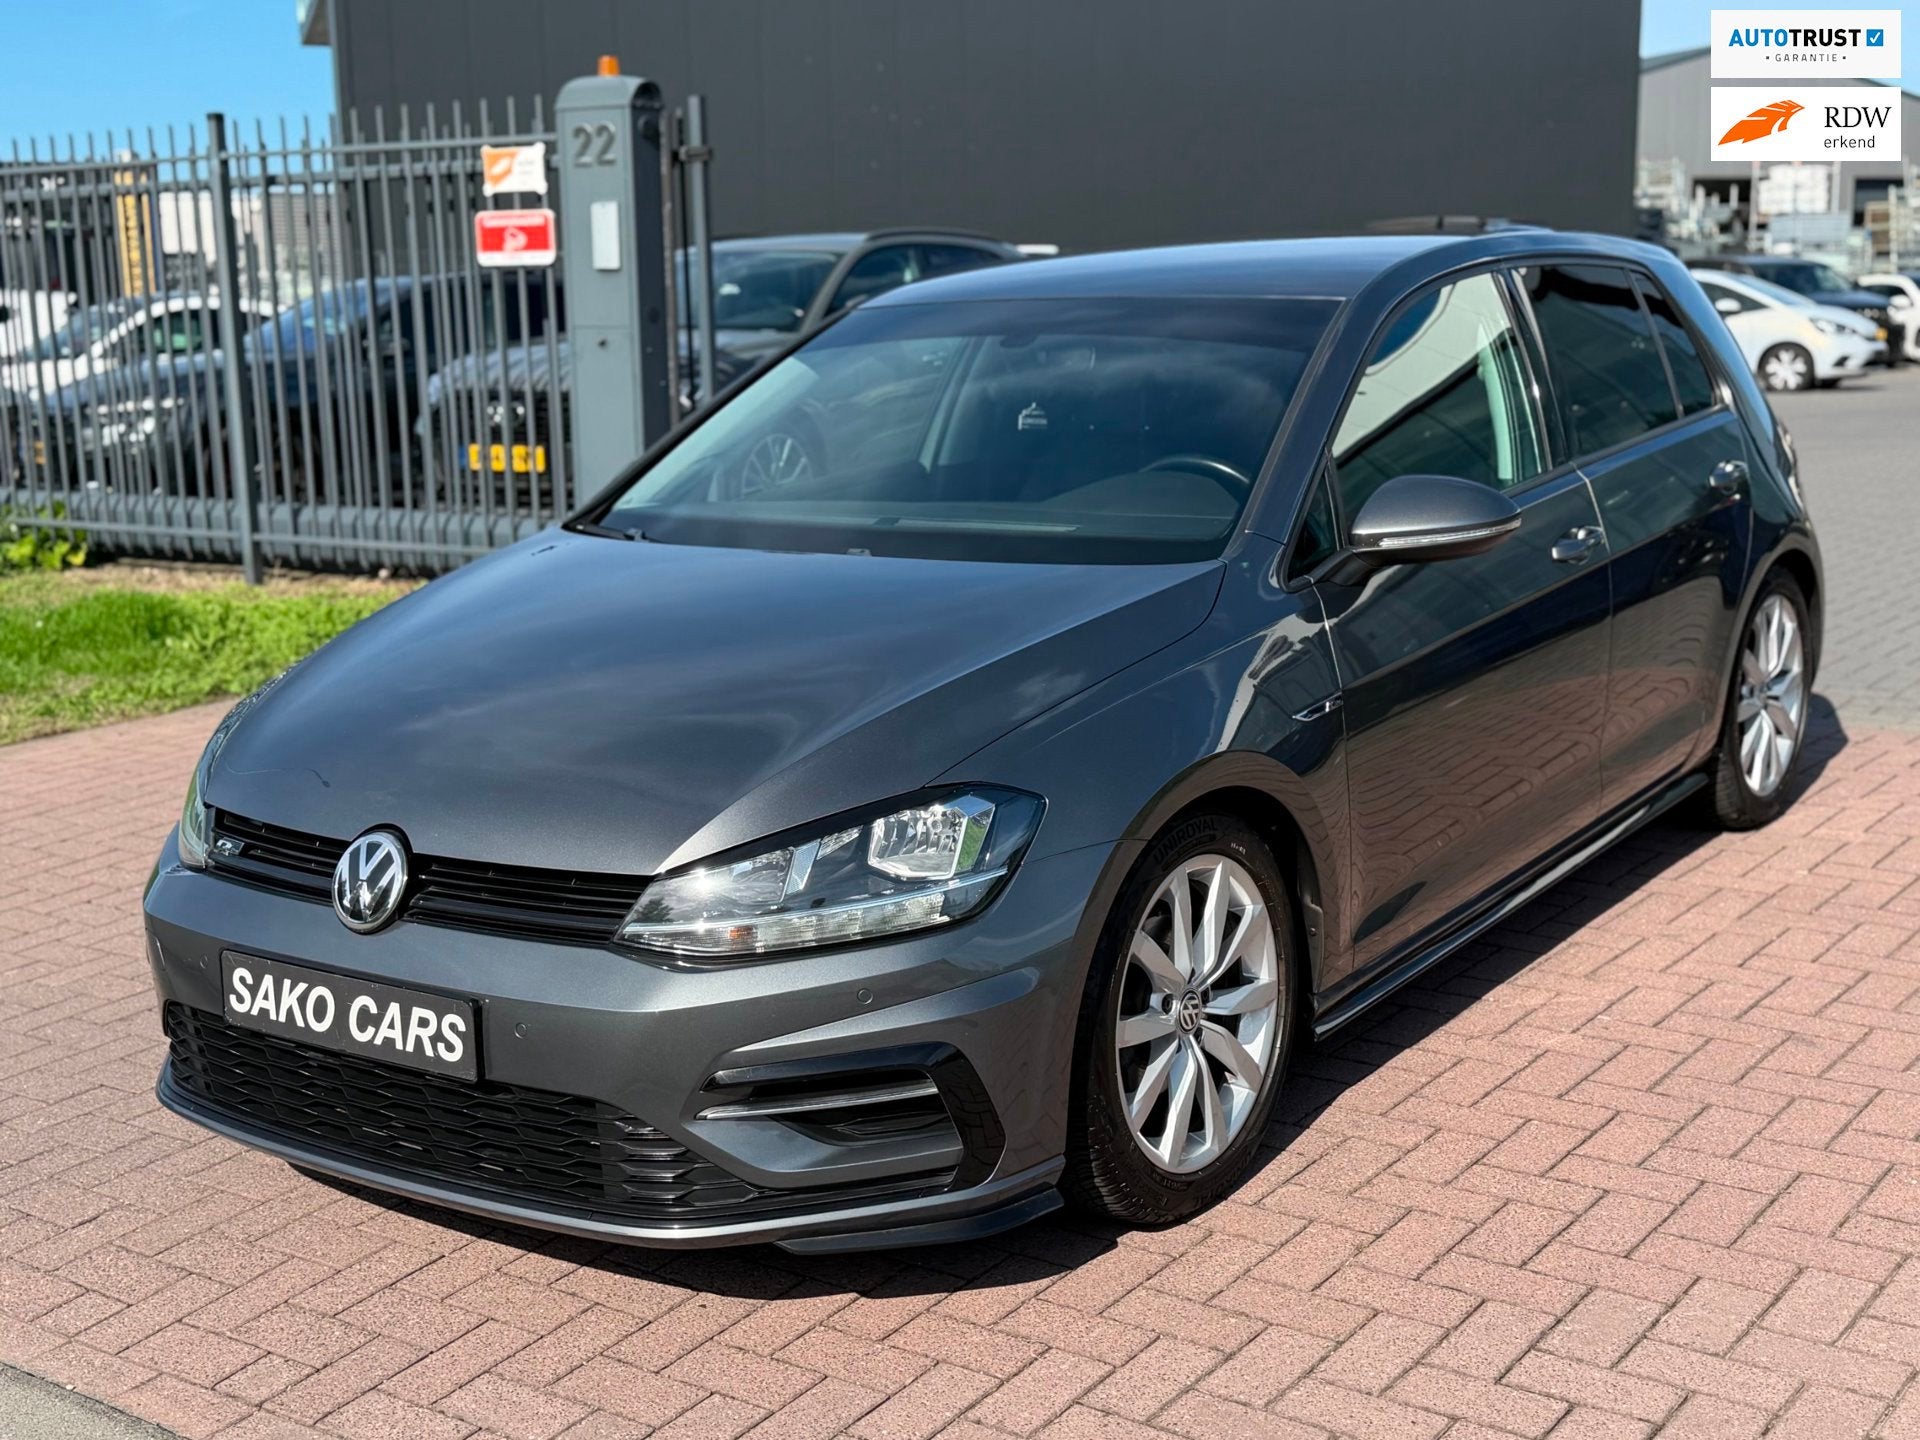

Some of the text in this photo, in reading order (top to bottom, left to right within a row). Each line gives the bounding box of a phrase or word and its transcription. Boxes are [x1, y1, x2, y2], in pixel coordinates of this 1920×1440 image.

[572, 121, 617, 168] 22
[229, 966, 467, 1063] SAKO CARS
